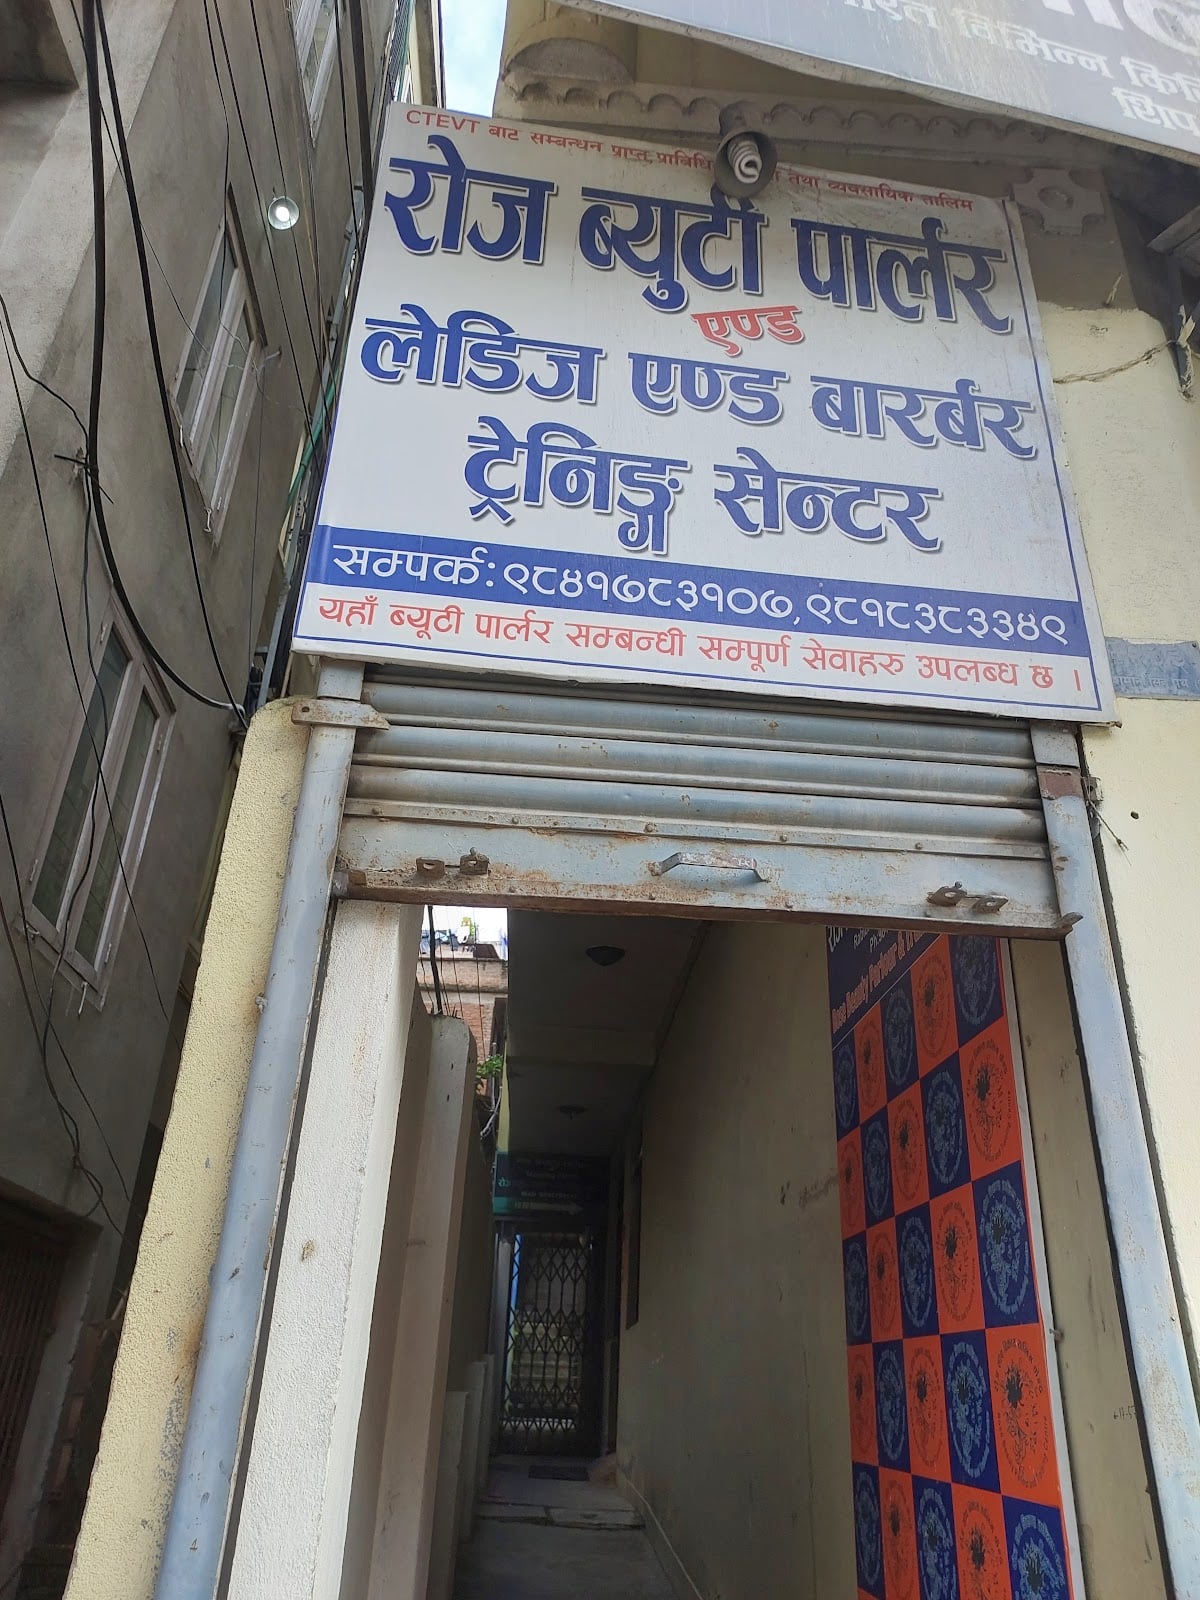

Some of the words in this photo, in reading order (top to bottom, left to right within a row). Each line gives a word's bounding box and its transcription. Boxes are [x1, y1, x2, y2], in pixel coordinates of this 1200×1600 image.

[406, 110, 480, 134] CTEVT
[488, 124, 521, 142] बाट
[530, 132, 604, 153] सम्बन्धन
[656, 149, 716, 172] प्राविधि
[788, 172, 819, 188] तथा
[383, 134, 558, 264] रोज
[578, 183, 769, 312] ब्युटी
[790, 216, 1012, 334] पार्लर
[360, 303, 606, 404] लेडिज
[628, 352, 789, 425] एण्ड
[690, 305, 806, 357] एण्ड
[463, 415, 692, 555] ट्रेनिङ्ग
[713, 446, 944, 552] सेन्टर
[319, 595, 379, 627] यहाँ
[389, 604, 465, 640] ब्यूटी
[475, 609, 554, 643] पार्लर
[565, 622, 687, 657] सम्बन्धी
[697, 635, 792, 672] सम्पूर्ण
[801, 639, 905, 677] सेवाहरु
[916, 655, 1019, 686] उपलब्ध
[1029, 664, 1055, 689] छ
[333, 545, 496, 588] सम्पर्क:
[806, 593, 1069, 645] ९८१८३८३३४९
